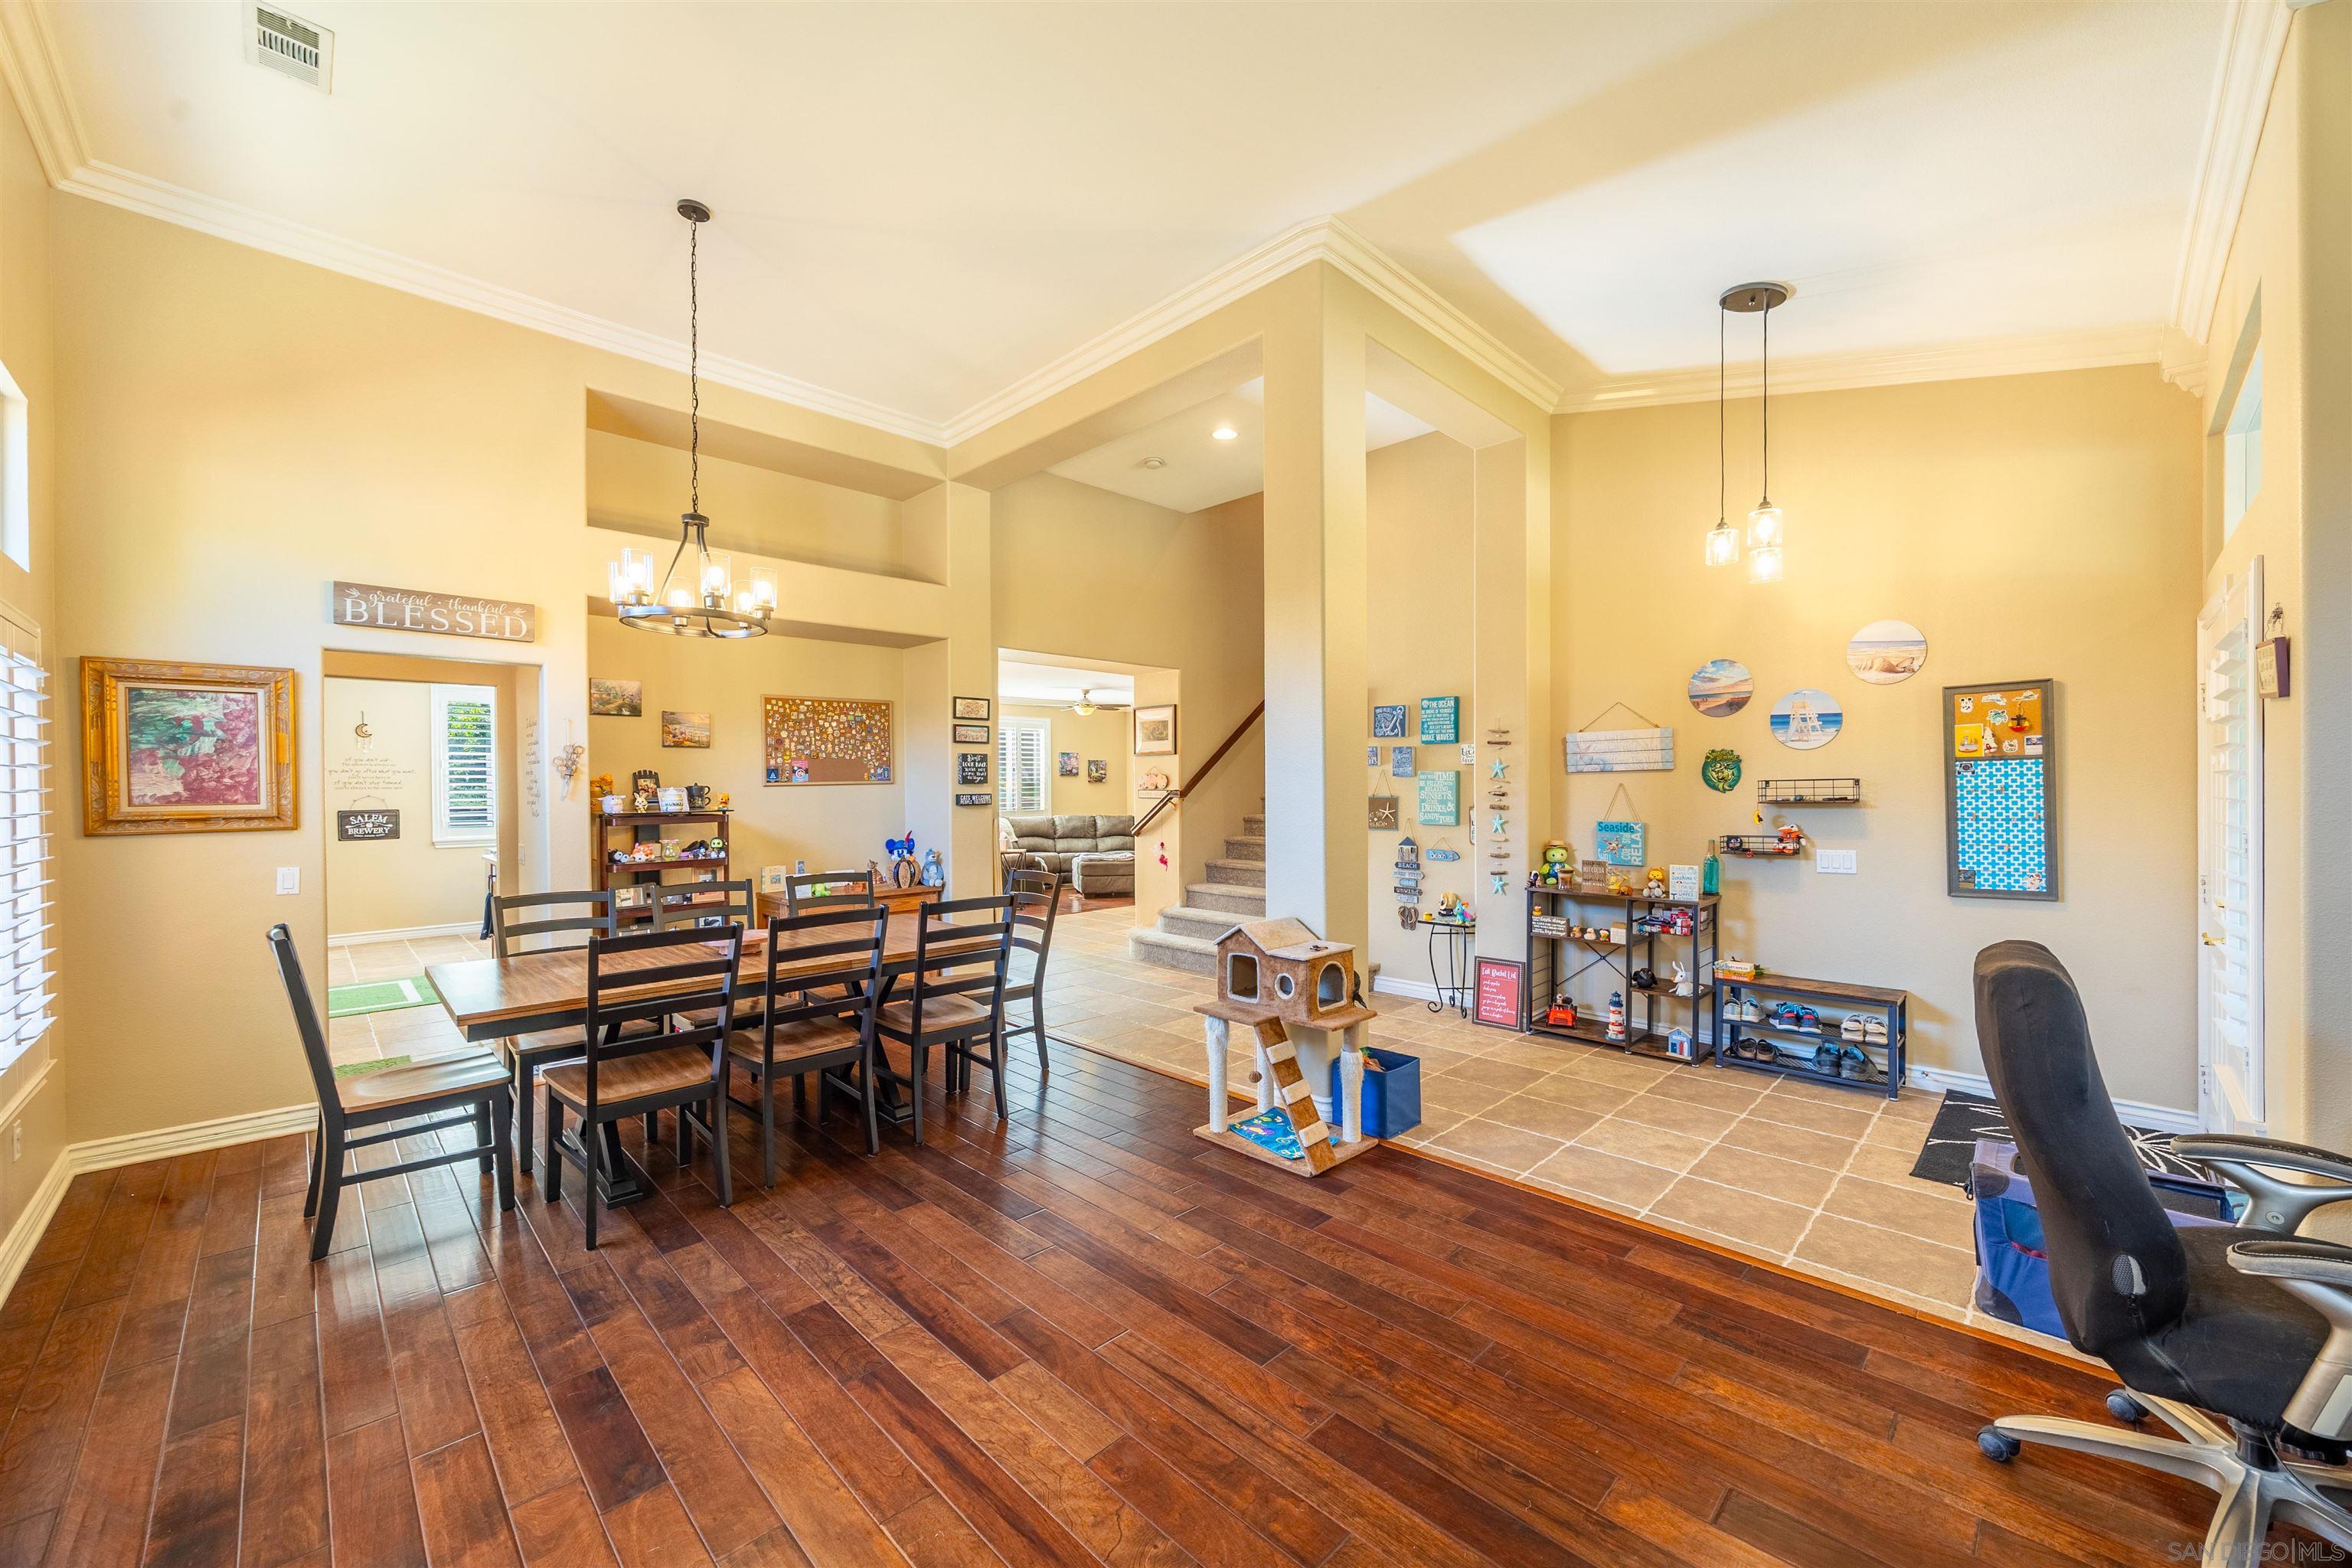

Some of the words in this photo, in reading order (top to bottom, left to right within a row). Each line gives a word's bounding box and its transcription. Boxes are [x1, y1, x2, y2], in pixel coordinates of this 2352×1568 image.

[368, 590, 432, 607] grateful
[446, 598, 507, 615] thankful
[344, 598, 528, 638] BLESSED
[1434, 772, 1455, 780] TIME
[1420, 790, 1453, 800] SUNSETS,
[1421, 803, 1447, 812] DRINKS,
[1446, 801, 1455, 811] &
[350, 814, 388, 824] SALEM
[1419, 812, 1440, 821] SANDY
[1598, 822, 1635, 833] Seaside
[1631, 823, 1642, 864] RELAX
[1481, 967, 1491, 975] Fall
[1491, 969, 1507, 978] Bucket
[1508, 971, 1517, 979] List
